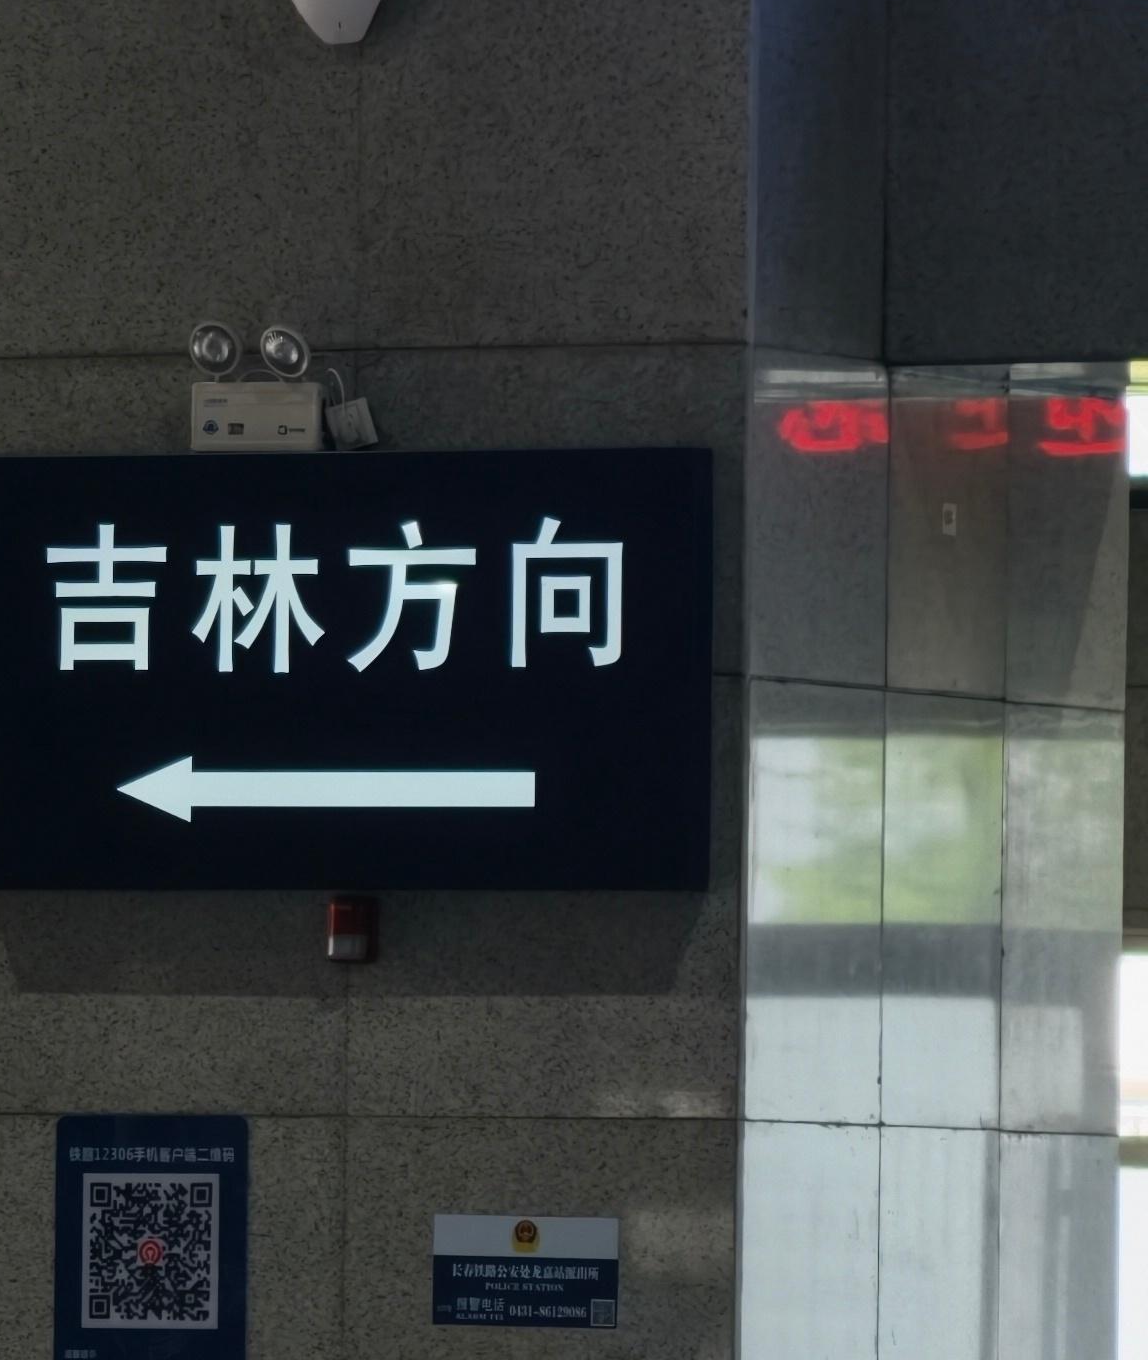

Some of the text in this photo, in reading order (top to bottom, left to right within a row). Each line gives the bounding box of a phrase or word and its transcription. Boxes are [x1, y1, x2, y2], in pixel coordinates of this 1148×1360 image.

[45, 516, 624, 674] 吉林方向
[484, 1282, 520, 1291] POLICE
